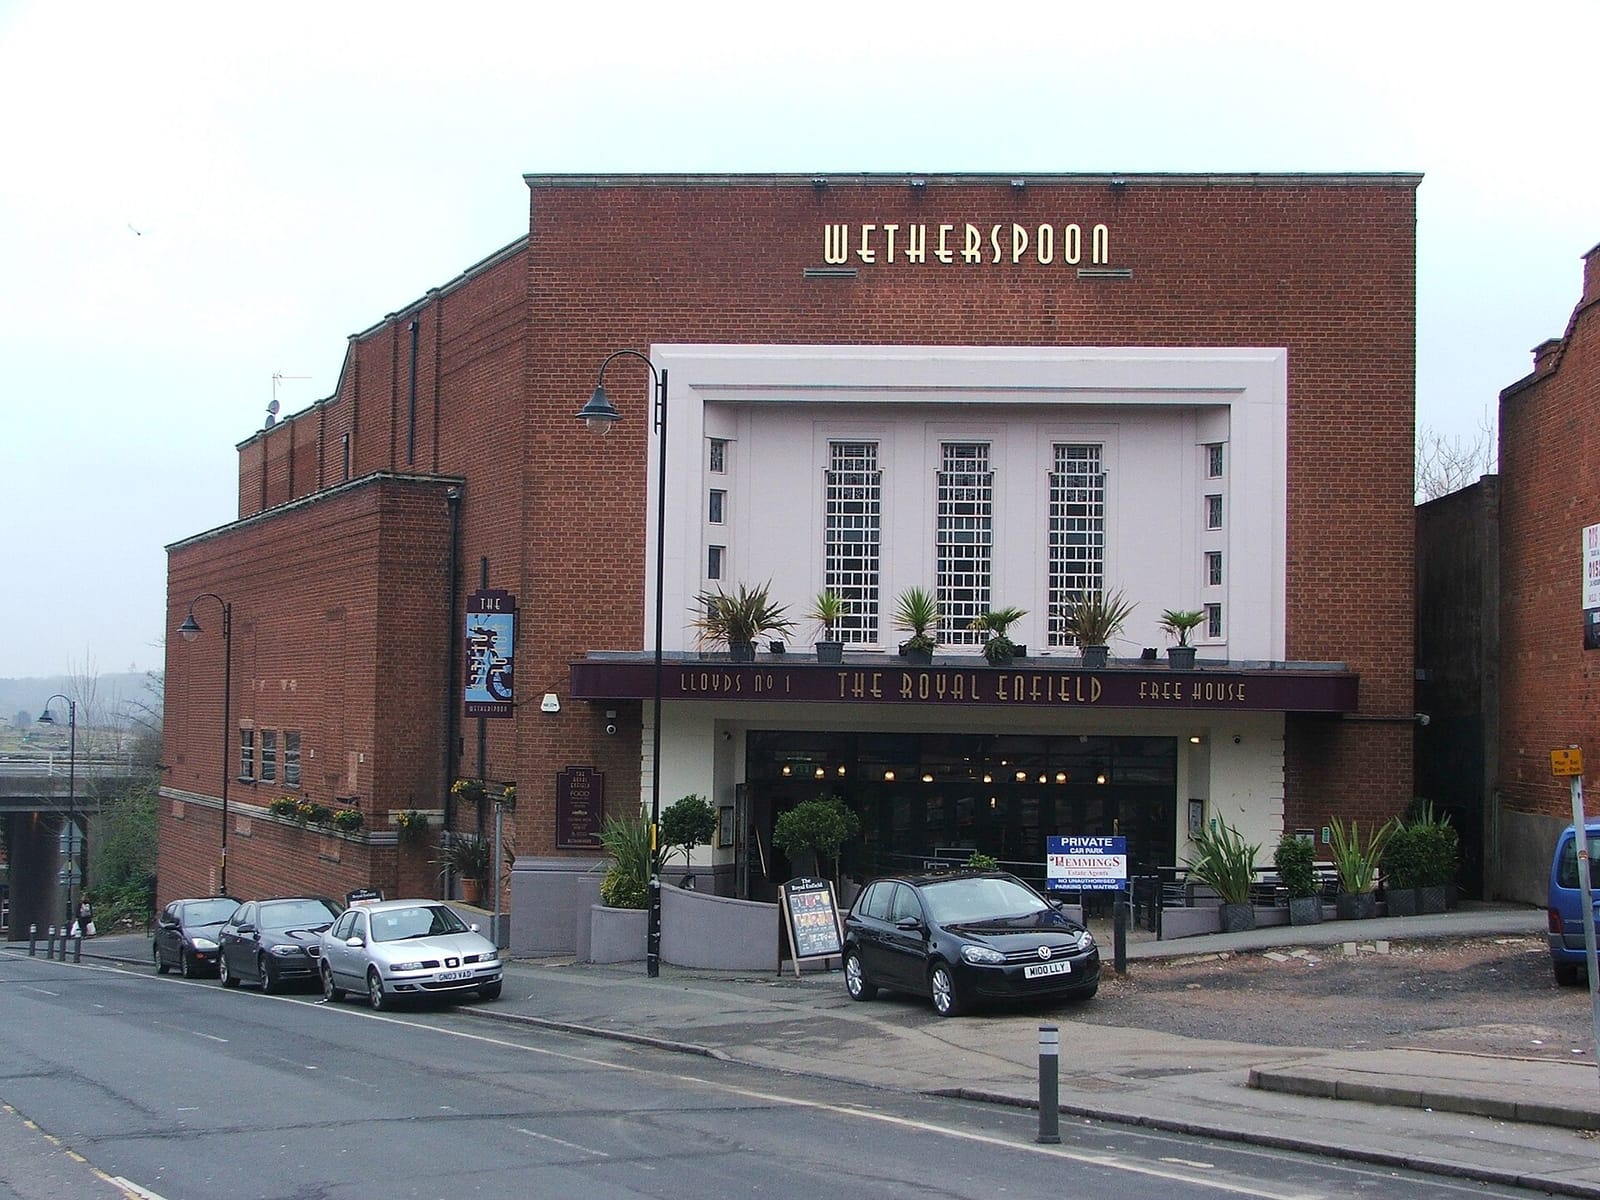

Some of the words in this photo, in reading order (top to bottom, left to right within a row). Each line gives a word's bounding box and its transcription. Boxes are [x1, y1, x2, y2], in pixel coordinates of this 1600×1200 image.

[823, 223, 1109, 265] WETHERSPOON
[480, 598, 501, 610] THE
[681, 673, 741, 692] LLOYDS
[785, 674, 791, 693] 1
[838, 672, 882, 698] THE
[900, 673, 980, 700] ROYAL
[996, 675, 1101, 703] ENFIELD
[1138, 681, 1182, 700] FREE
[1191, 682, 1246, 701] HOUSE
[1061, 837, 1113, 846] PRIVATE
[1055, 856, 1120, 867] HEMMINGS
[791, 883, 806, 891] Royal
[1049, 962, 1065, 974] LLY
